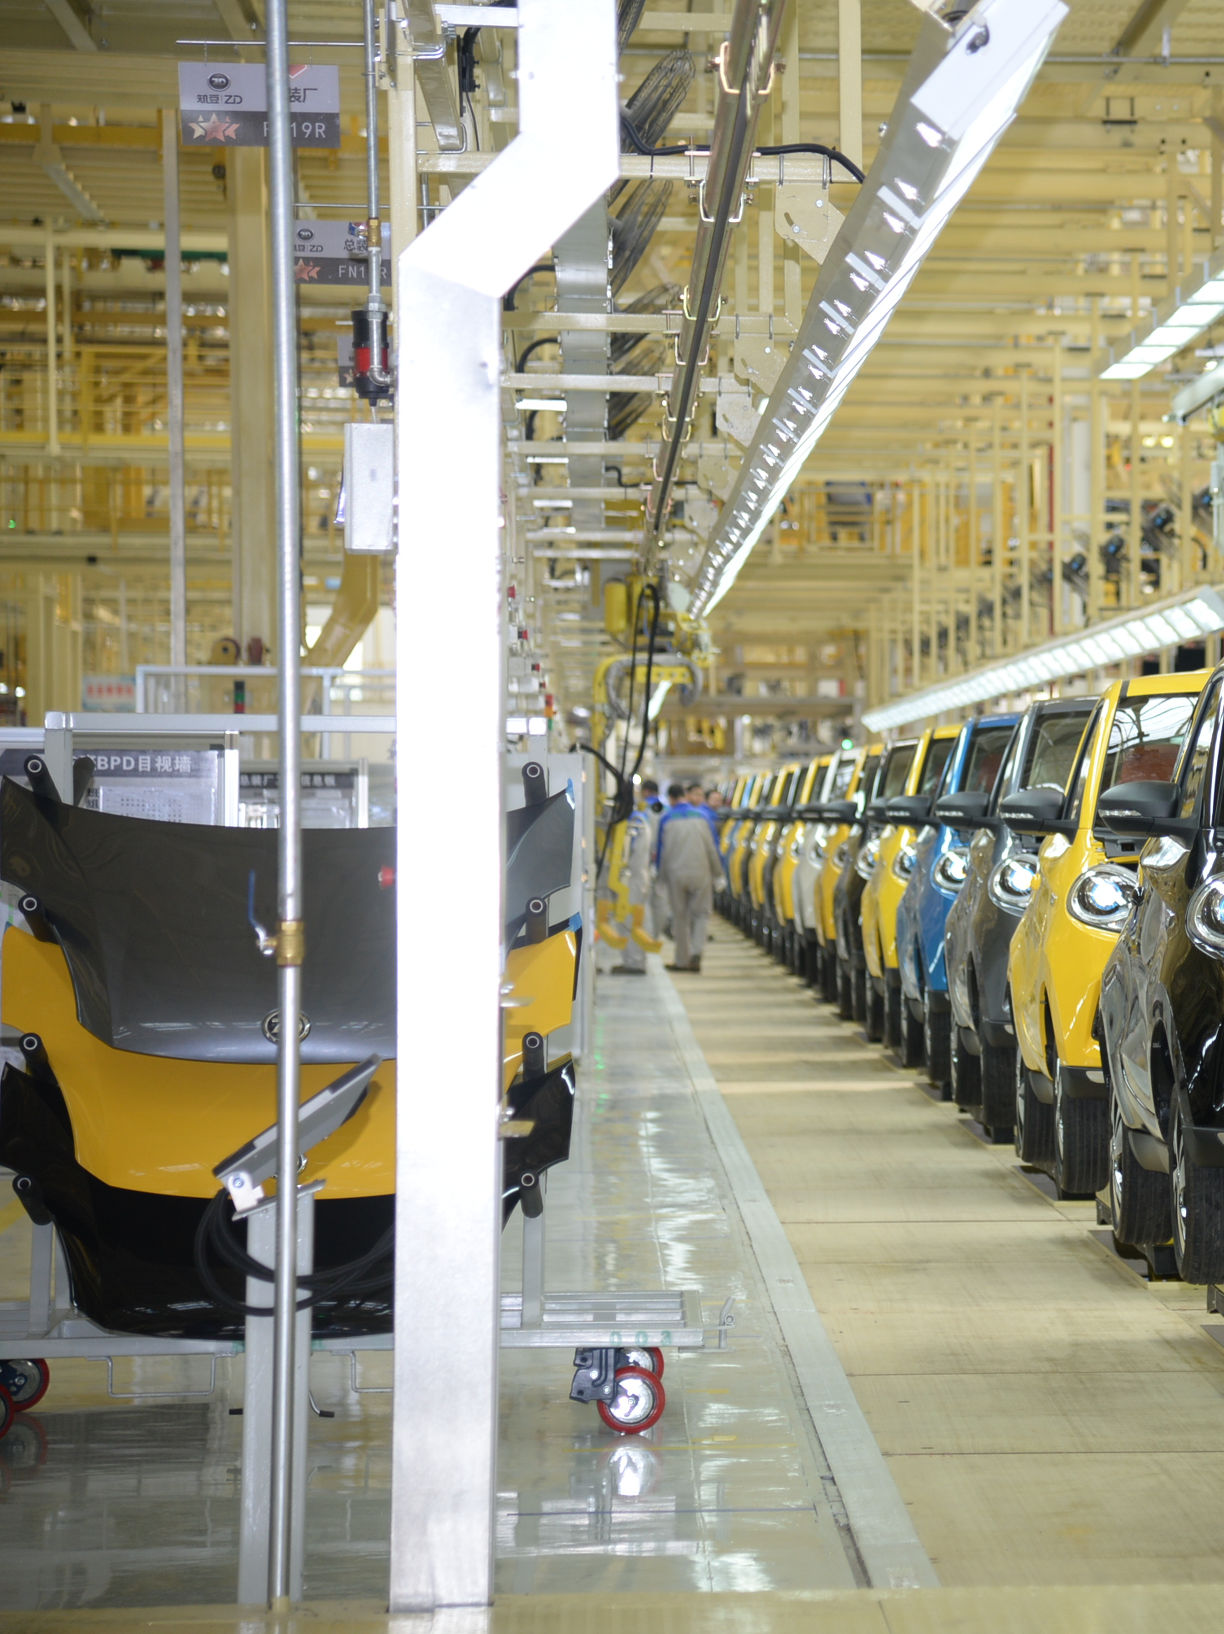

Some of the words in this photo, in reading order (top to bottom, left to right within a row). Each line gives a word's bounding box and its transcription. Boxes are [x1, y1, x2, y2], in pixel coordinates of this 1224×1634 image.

[288, 87, 318, 103] 装厂
[263, 121, 326, 138] F19R
[338, 264, 388, 279] FN1R
